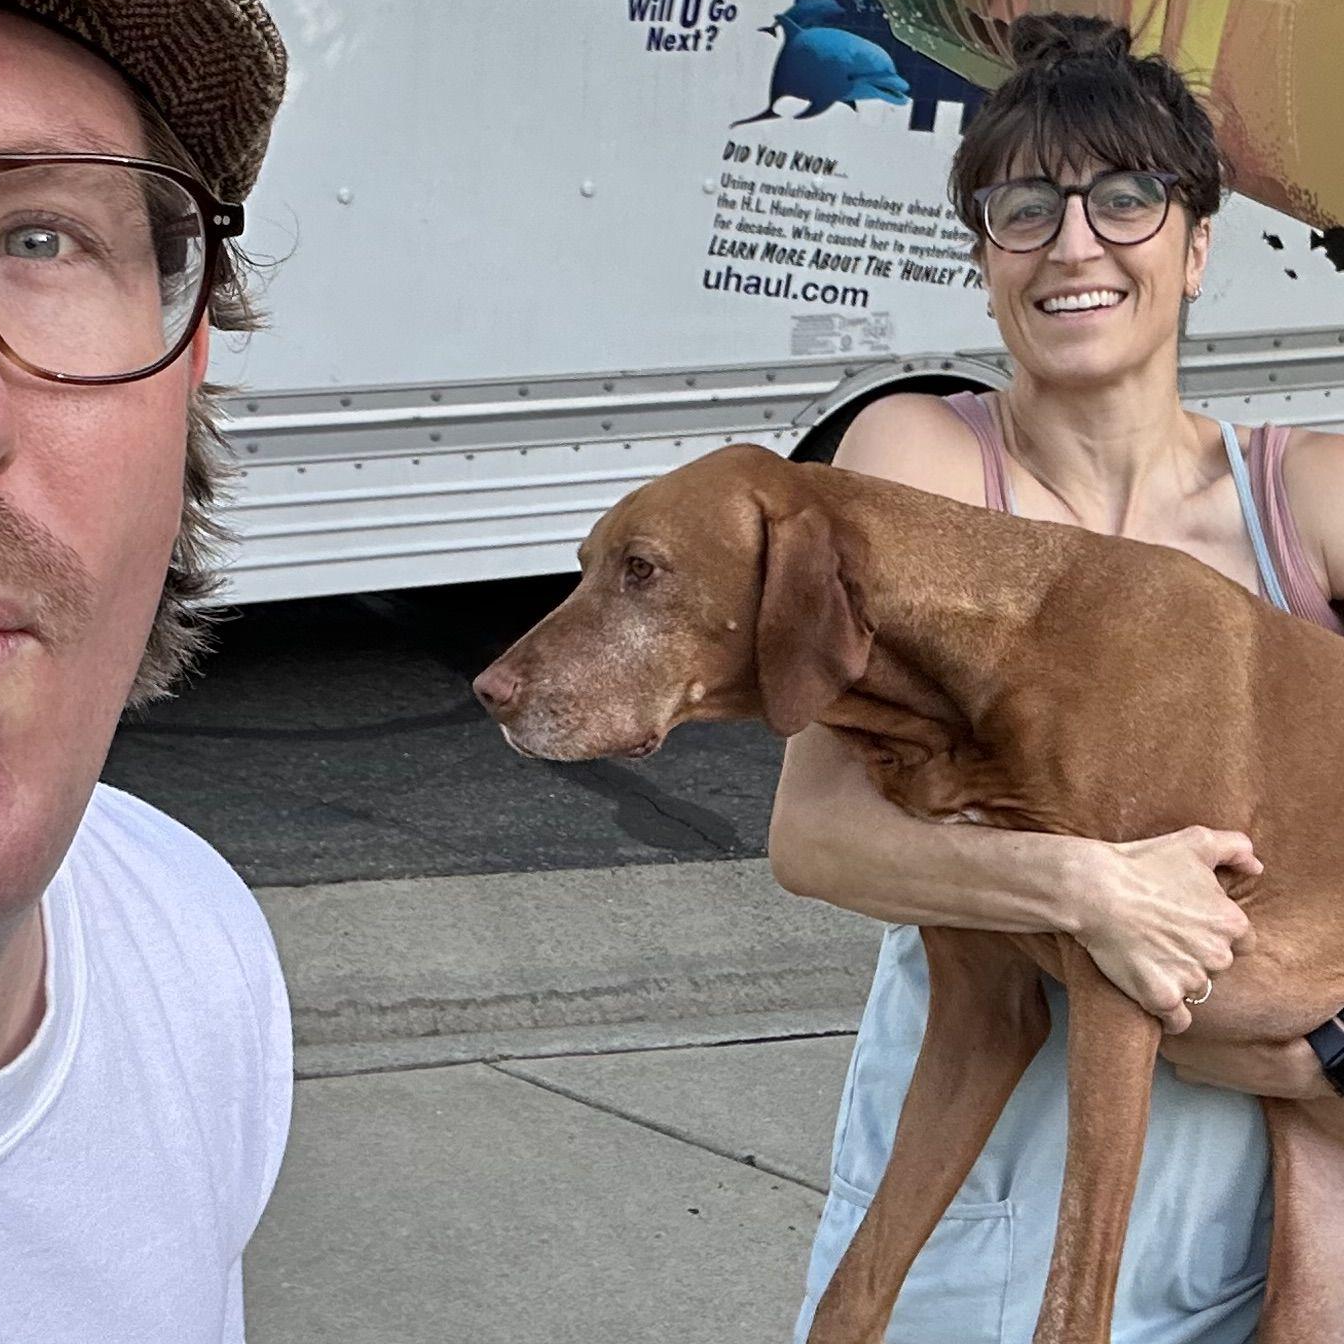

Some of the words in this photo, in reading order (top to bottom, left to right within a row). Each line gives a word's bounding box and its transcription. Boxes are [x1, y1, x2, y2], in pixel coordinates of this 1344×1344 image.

[646, 25, 719, 52] Next?
[722, 140, 751, 162] DID
[756, 144, 787, 169] YOU
[720, 172, 755, 195] Using
[760, 182, 836, 205] revolutionary
[842, 191, 904, 216] technology
[792, 224, 824, 243] What
[826, 231, 868, 249] caused
[870, 234, 890, 252] her
[864, 213, 938, 238] international
[708, 235, 759, 261] LEARN
[760, 241, 807, 267] MORE
[808, 248, 862, 274] ABOUT
[864, 254, 894, 278] THE
[703, 265, 869, 308] uhaul.com
